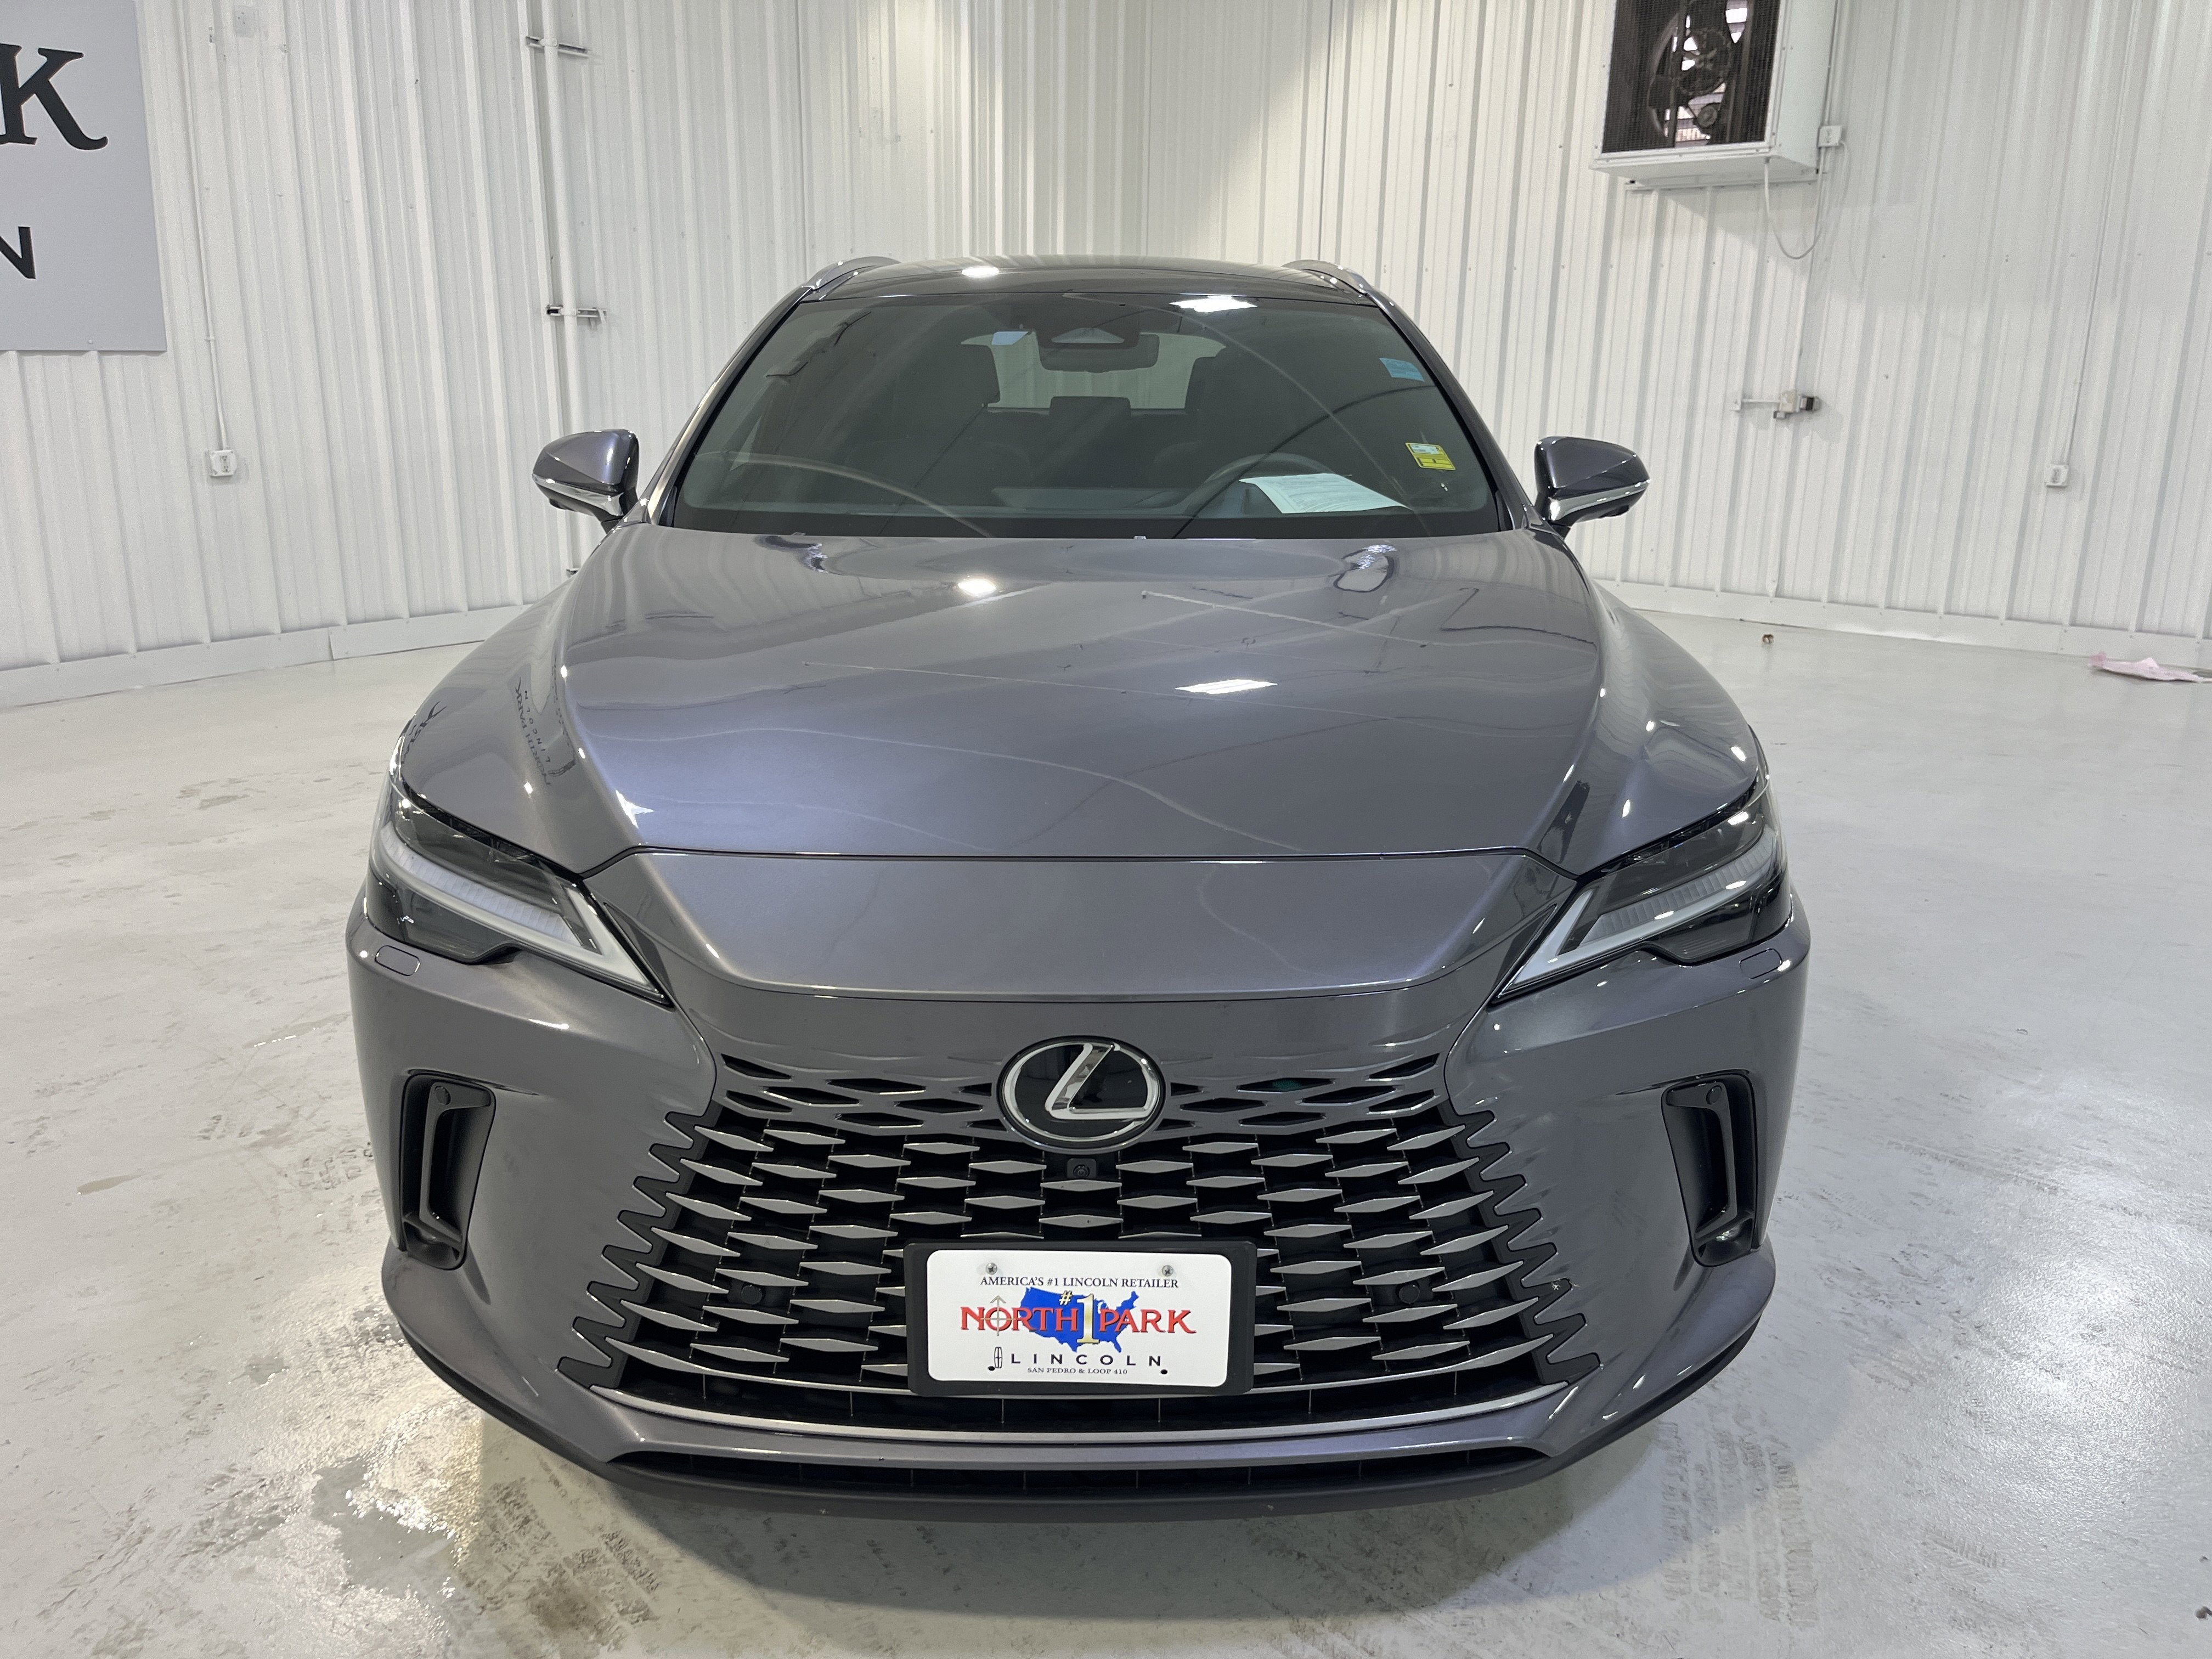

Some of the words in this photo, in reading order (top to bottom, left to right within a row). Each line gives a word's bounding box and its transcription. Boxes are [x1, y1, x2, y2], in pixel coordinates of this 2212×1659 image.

[980, 1276, 1044, 1286] AMERICA'S
[1047, 1277, 1059, 1286] #1
[1063, 1277, 1118, 1287] LINCOLN
[1121, 1278, 1179, 1288] RETAILER
[960, 1306, 1080, 1332] NORTH
[1099, 1307, 1197, 1334] PARK
[1011, 1353, 1161, 1366] LINCOLN
